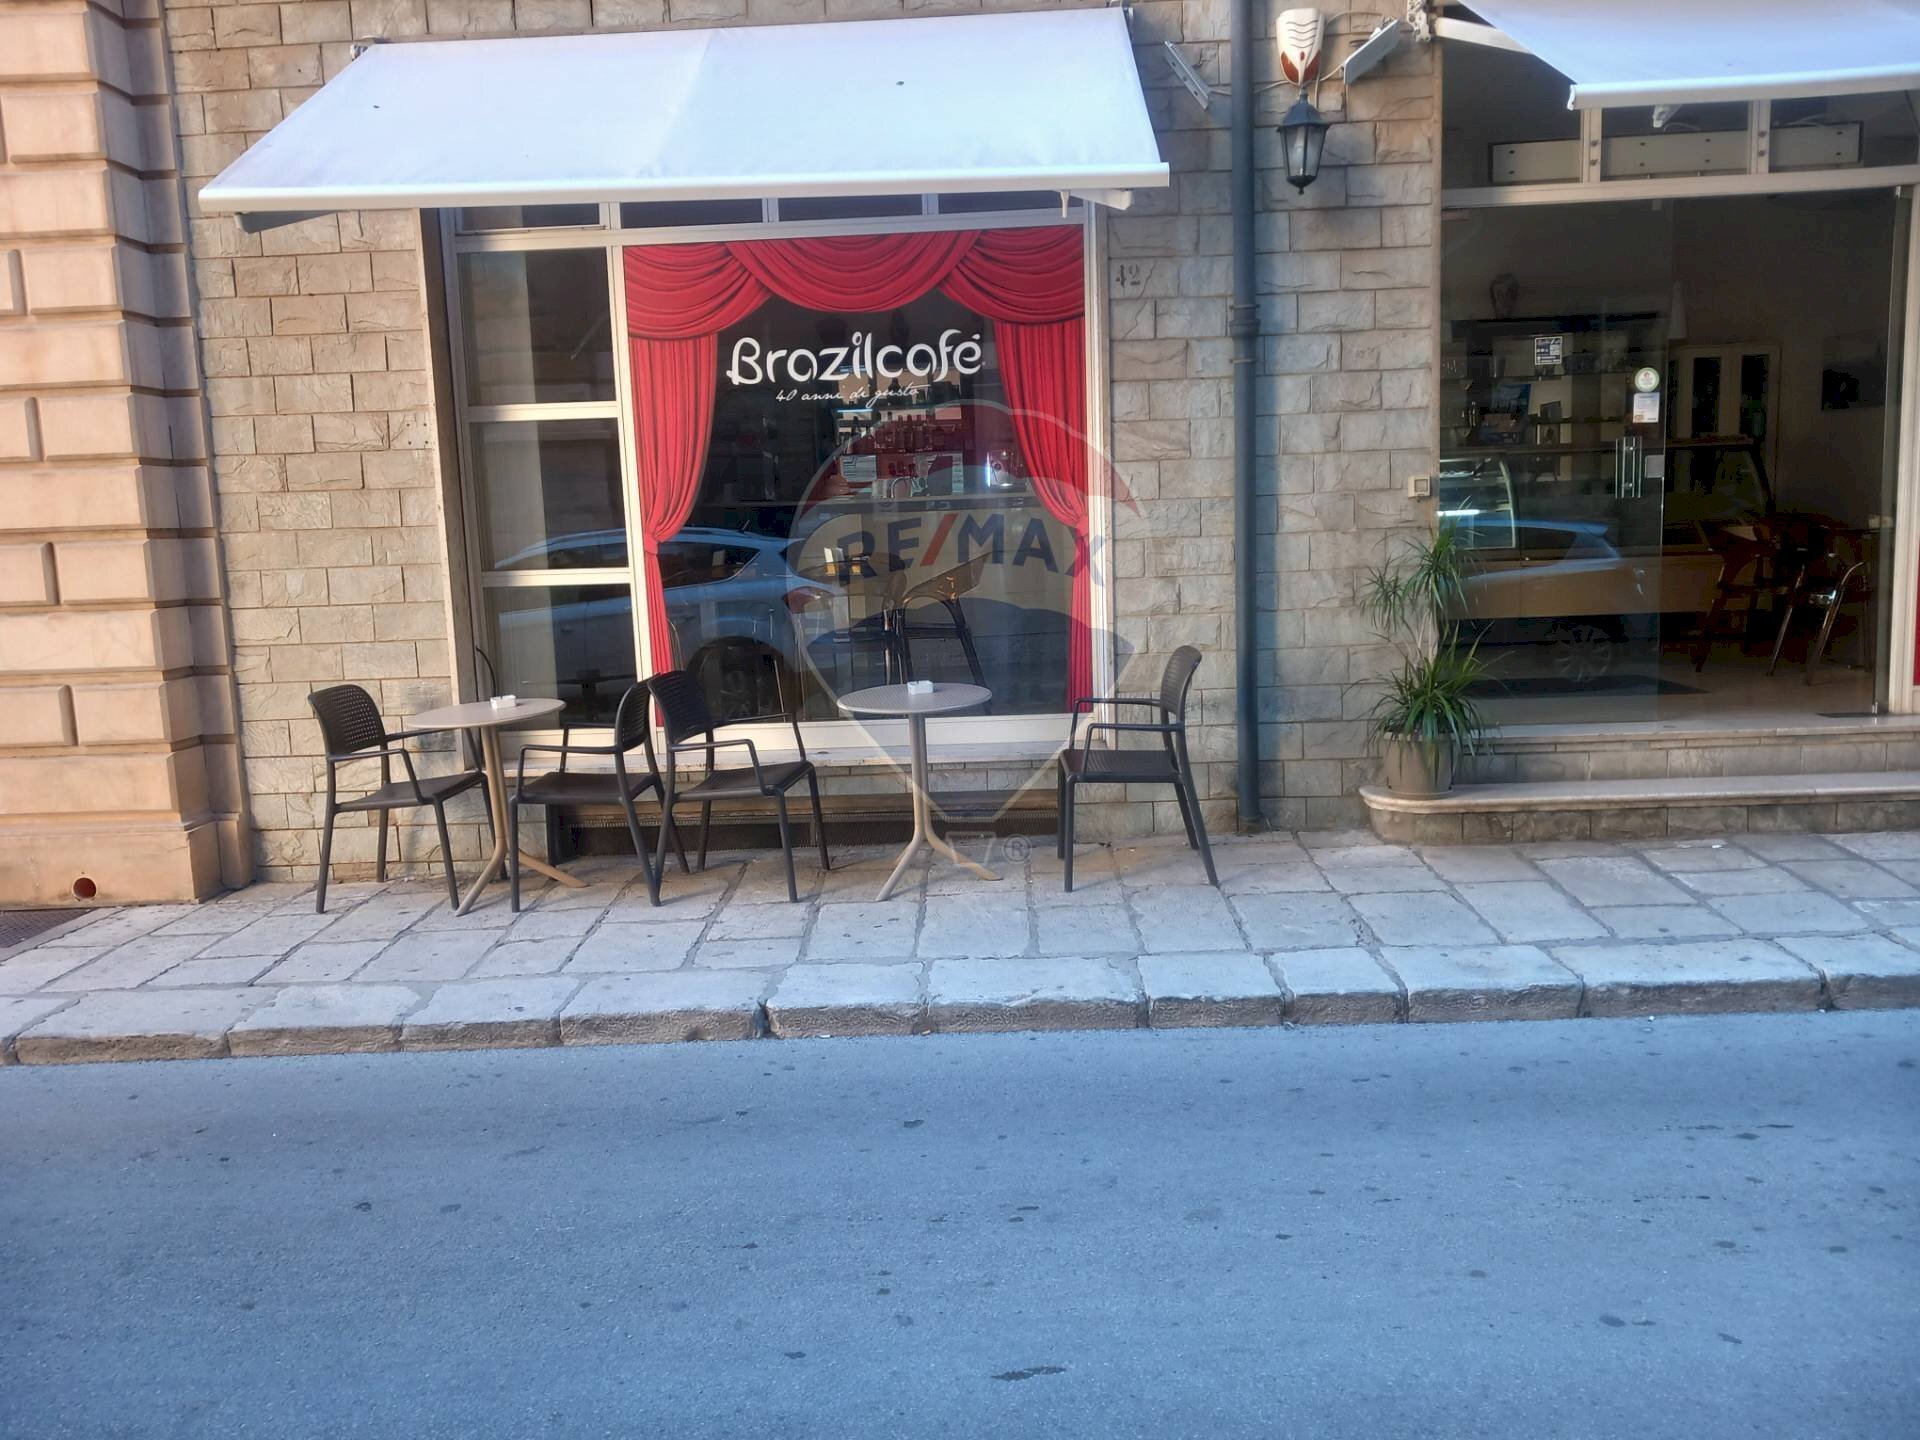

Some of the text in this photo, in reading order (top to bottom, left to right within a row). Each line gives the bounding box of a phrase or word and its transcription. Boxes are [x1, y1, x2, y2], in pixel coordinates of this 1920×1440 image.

[726, 328, 983, 385] Brazilcafé
[801, 386, 844, 401] anni
[849, 385, 871, 399] di
[865, 382, 931, 408] gusto
